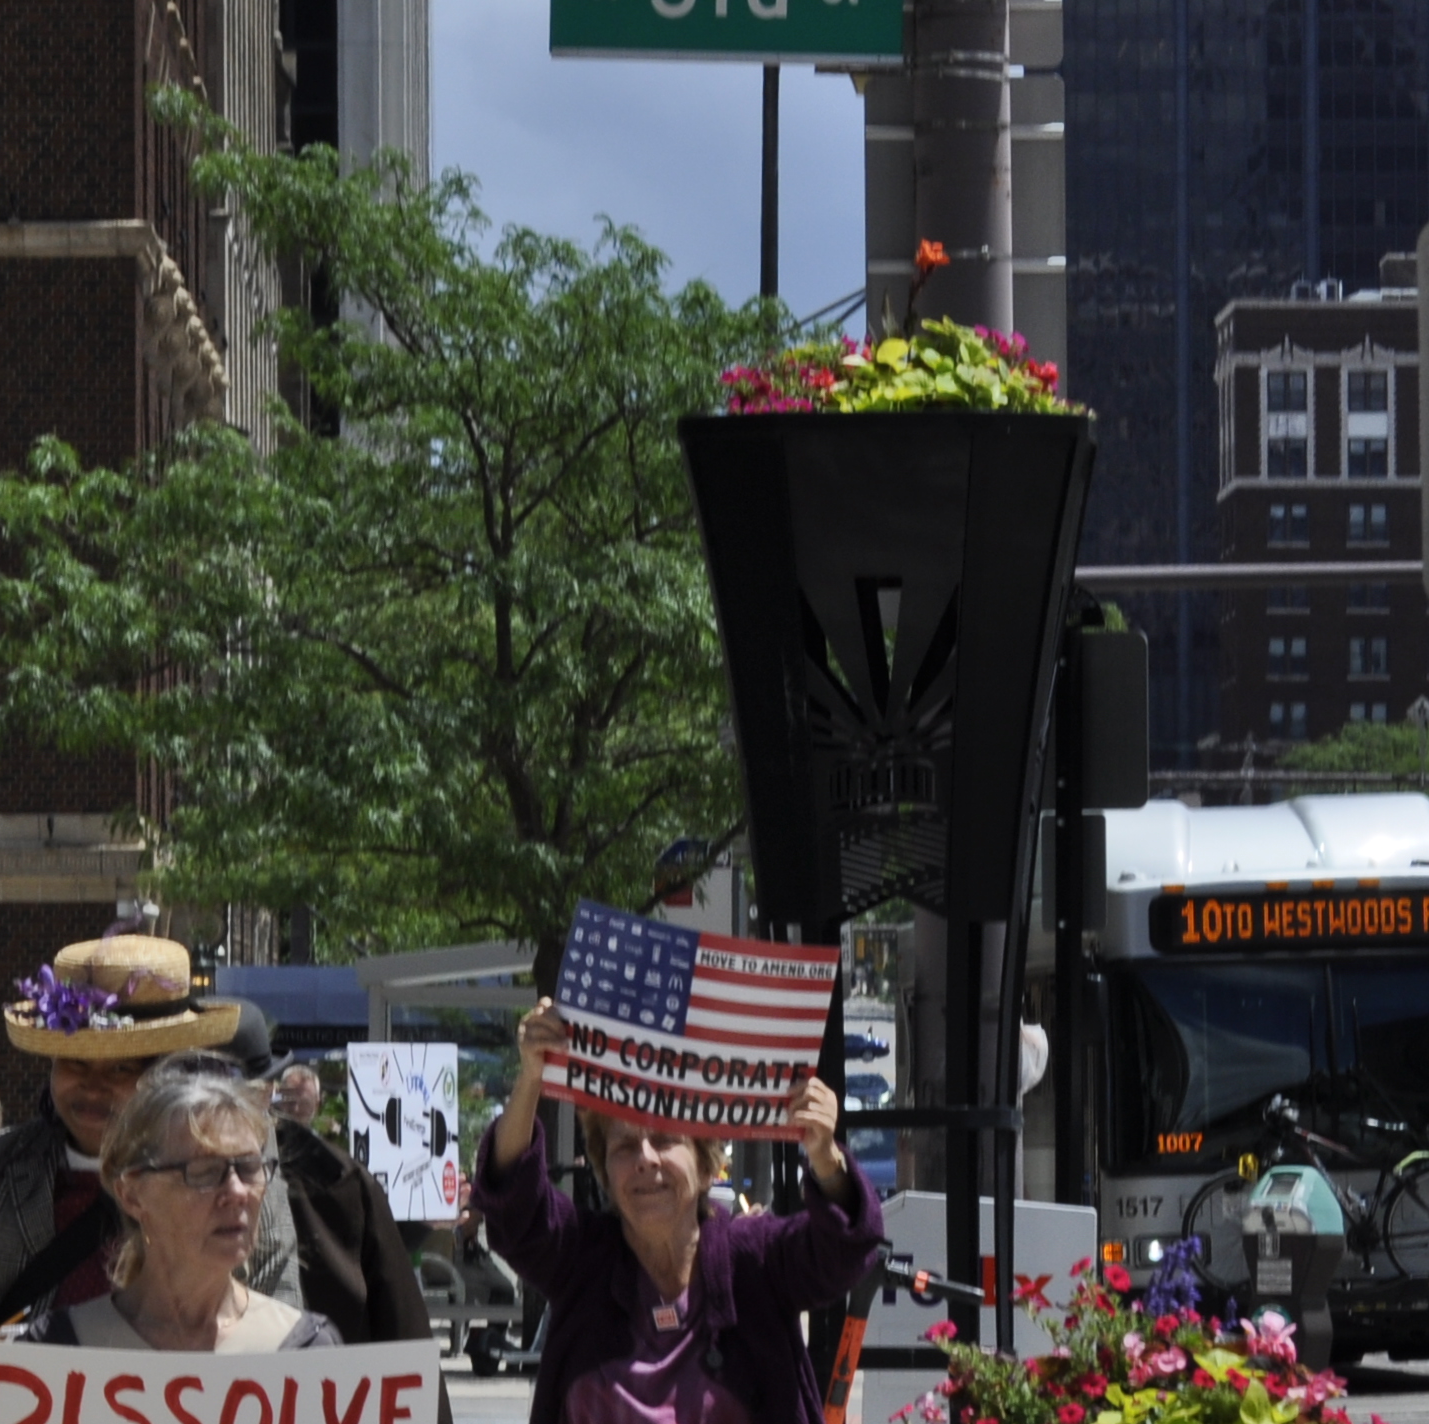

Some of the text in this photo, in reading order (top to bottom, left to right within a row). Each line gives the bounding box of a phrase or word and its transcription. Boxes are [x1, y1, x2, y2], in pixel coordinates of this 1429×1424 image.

[1263, 897, 1412, 940] WESTWOODS
[700, 951, 736, 970] MOVE
[741, 959, 757, 972] TO
[564, 1019, 809, 1091] ND CORPORATE
[566, 1060, 783, 1127] PERSONHOOD!
[1156, 1132, 1203, 1155] 1007
[1116, 1194, 1164, 1218] 1517
